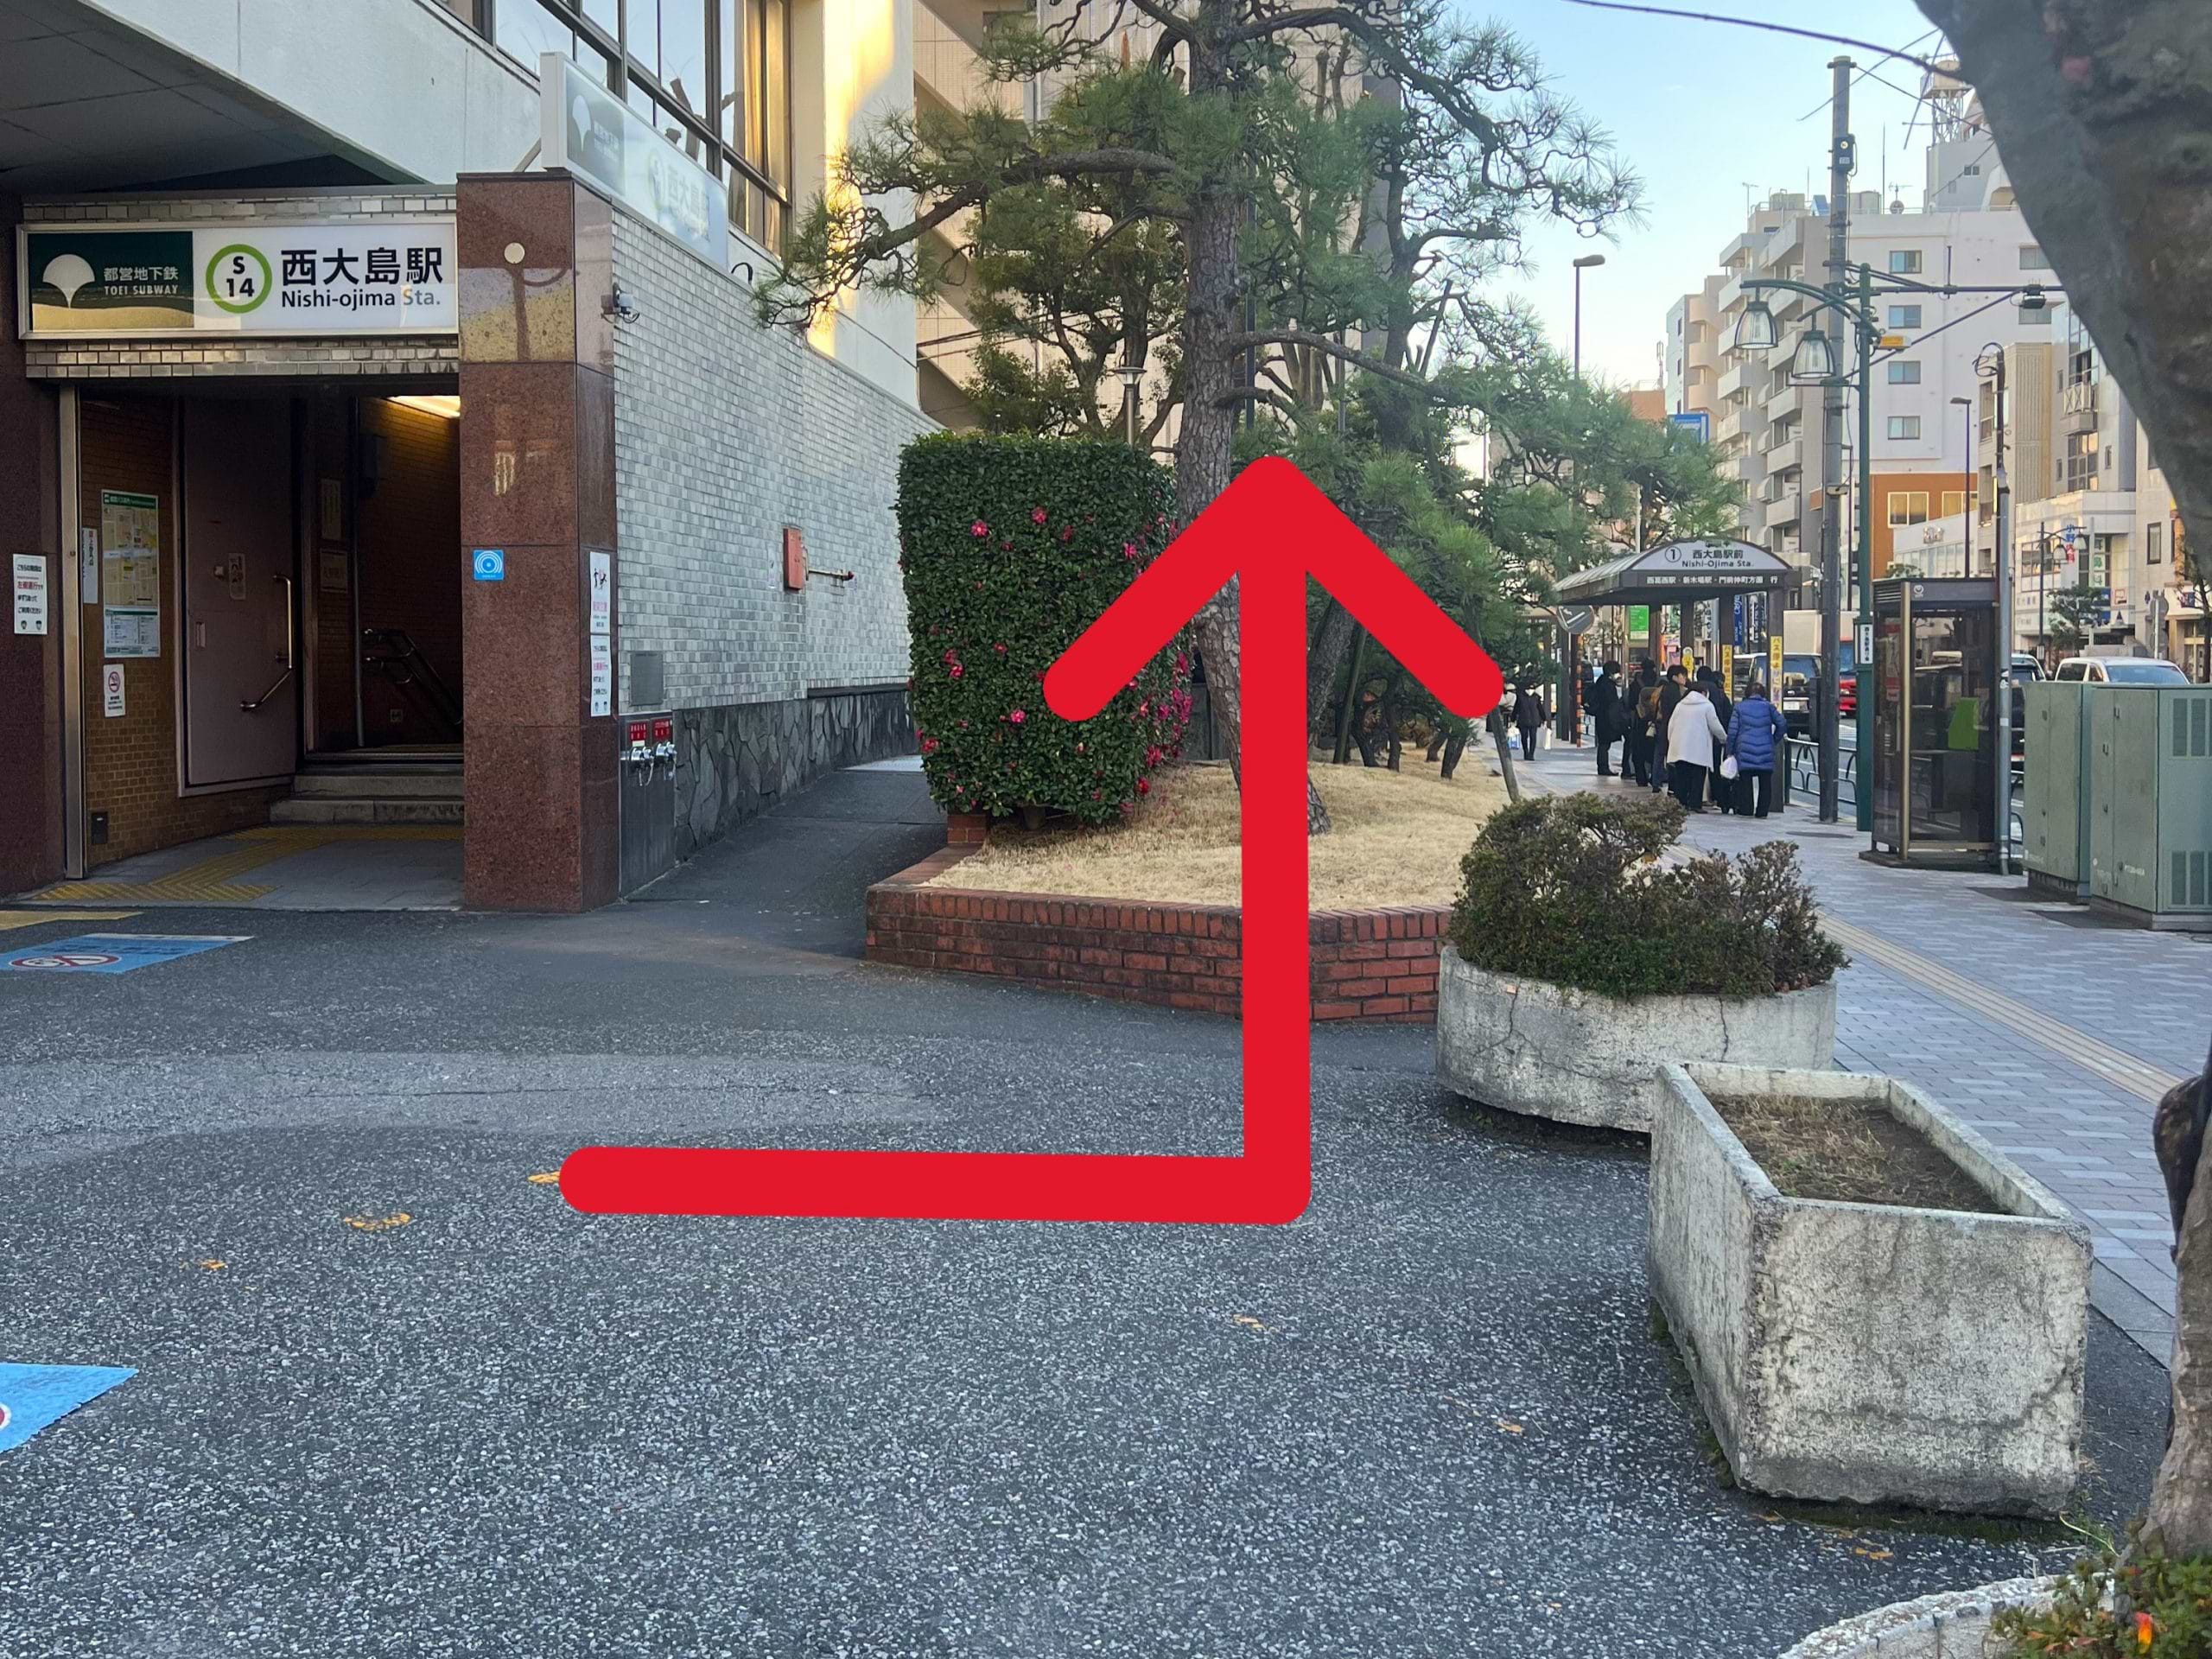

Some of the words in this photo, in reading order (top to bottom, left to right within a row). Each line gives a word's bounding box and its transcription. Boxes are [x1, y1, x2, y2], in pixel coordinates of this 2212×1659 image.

[104, 265, 179, 281] 都営地下鉄
[232, 256, 246, 275] S
[281, 247, 442, 285] 西大島駅
[104, 284, 129, 296] TOEI
[133, 283, 179, 296] SUBWAY
[225, 277, 256, 298] 14
[281, 289, 395, 312] Nishi-ojima
[402, 287, 442, 307] Sta.
[1693, 549, 1744, 559] 西大島駅前
[1681, 560, 1733, 569] Nishi-Ojima
[1737, 559, 1754, 568] Sta.
